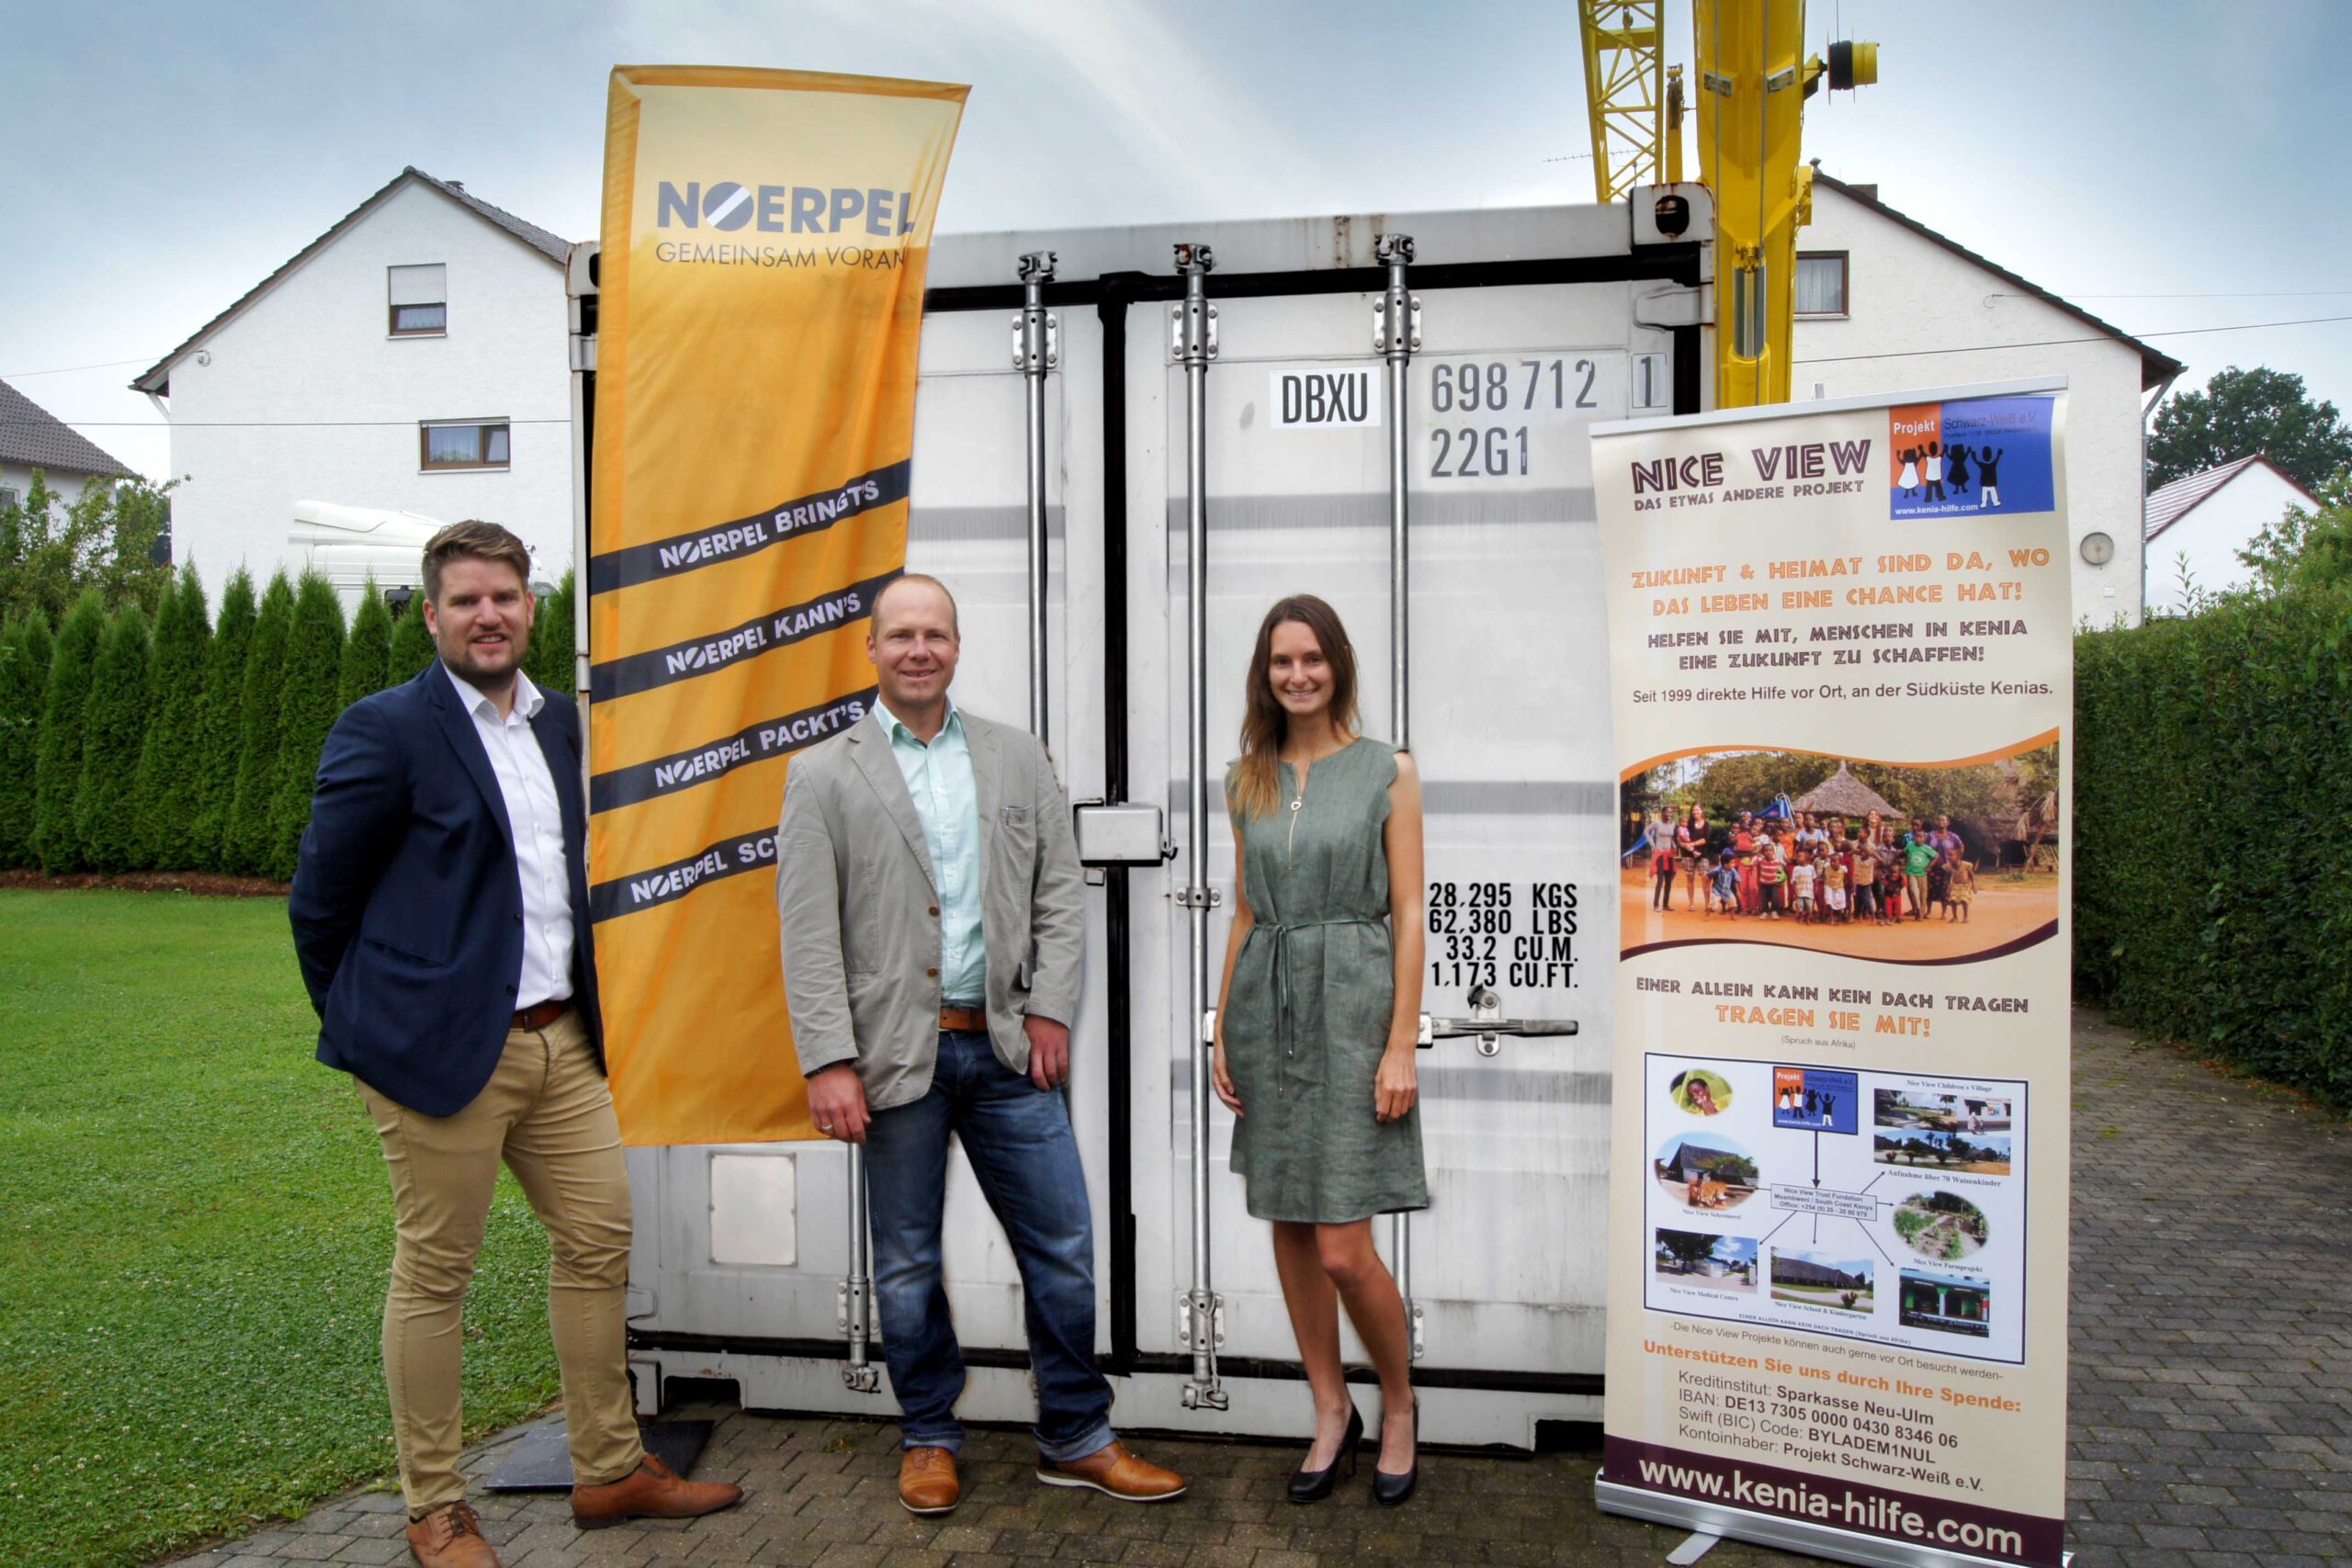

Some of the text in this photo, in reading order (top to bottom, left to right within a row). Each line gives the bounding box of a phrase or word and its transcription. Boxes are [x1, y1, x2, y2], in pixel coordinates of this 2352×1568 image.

[656, 242, 906, 271] GEMEINSAM VORAN
[1282, 372, 1368, 423] DBXU
[1894, 420, 1935, 435] Projekt
[1430, 426, 1529, 478] 22G1
[1631, 439, 1871, 494] NICE VIEW
[1634, 480, 1864, 511] DAS ETWAS ANDERE PROJEKT
[1895, 504, 1978, 514] www.kenia-hilfe.com
[1632, 548, 2050, 588] ZUKUNFT & HEIMAT SIND DA, WO
[1653, 582, 2022, 616] DAS LEBEN EINE CHANCE HAT!
[1648, 619, 2028, 649] HELFEN SIE MIT, MENSCHEN IN KENIA
[1679, 646, 1984, 670] EINE ZUKUNFT ZU SCHAFFEN!
[1633, 680, 2052, 703] Seit 1999 direkte Hilfe vor Ort, an der Südküste Kenias.
[1429, 882, 1577, 908] 28,295 KGS
[1429, 909, 1577, 935] 62,380 LBS
[1446, 936, 1578, 962] 33.2 CU.M.
[1432, 962, 1578, 987] 1,173 CU.FT.
[1636, 977, 2029, 1013] EINER ALLEIN KANN KEIN DACH TRAGEN
[1715, 1004, 1930, 1037] TRAGEN SIE MIT!
[1781, 1035, 1813, 1046] (Spruch
[1830, 1039, 1856, 1049] Afrika)
[1777, 1072, 1800, 1081] Projekt
[1888, 1169, 1922, 1179] Aufnahme
[1925, 1173, 1939, 1181] über
[1952, 1176, 2001, 1186] Waisenkinder
[1692, 1325, 1713, 1336] Nice
[1716, 1329, 1738, 1338] View
[1742, 1332, 1781, 1345] Projekte
[1784, 1337, 1818, 1351] können
[1822, 1345, 1846, 1355] auch
[1849, 1349, 1876, 1360] gerne
[1880, 1355, 1895, 1363] vor
[1898, 1357, 1914, 1367] Ort
[1917, 1360, 1957, 1374] besucht
[1644, 1339, 2021, 1412] Unterstützen Sie uns durch Ihre Spende:
[1679, 1371, 1934, 1426] Kreditinstitut: Sparkasse Neu-Ulm
[1679, 1389, 1958, 1448] IBAN: DE13 7305 0000 0430 8346 06
[1679, 1406, 1936, 1464] Swift (BIC) Code: BYLADEM1NUL
[1679, 1425, 1984, 1492] Kontoinhaber: Projekt Schwarz-Weiß e.V.
[1638, 1460, 2021, 1556] www.kenia-hilfe.com
